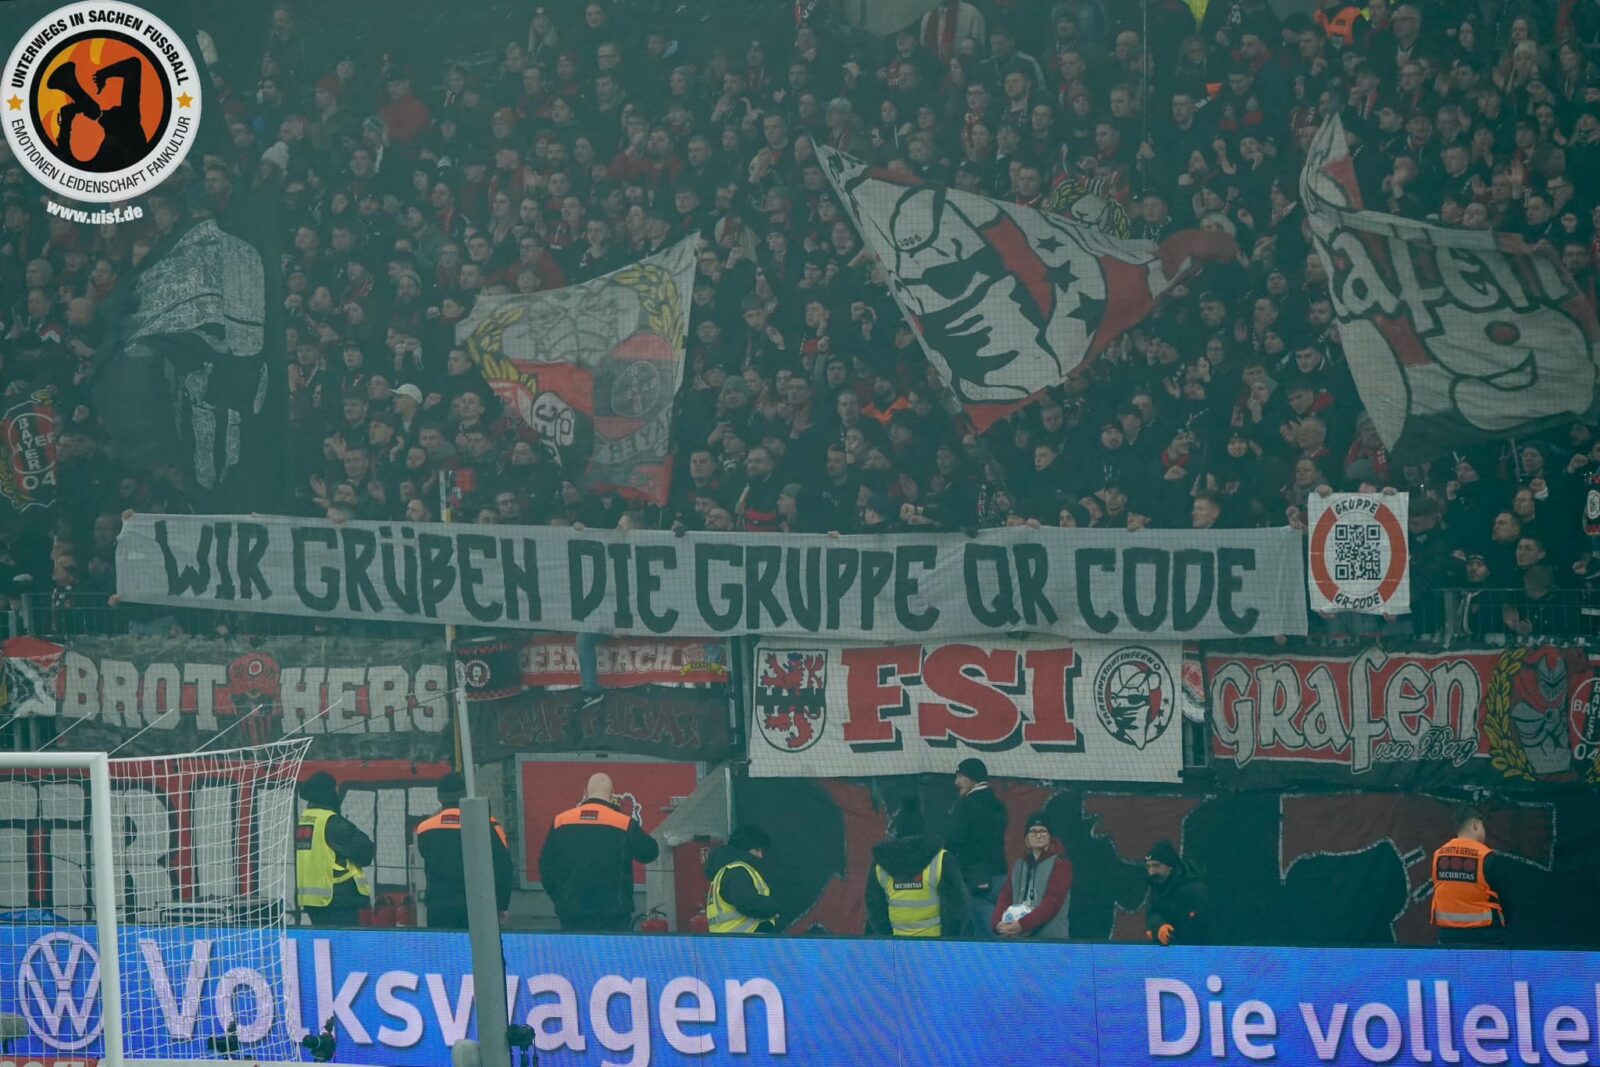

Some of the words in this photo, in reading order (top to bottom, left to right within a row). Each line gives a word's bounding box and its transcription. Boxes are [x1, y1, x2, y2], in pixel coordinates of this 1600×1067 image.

[1335, 498, 1378, 515] GRUPPE
[153, 519, 273, 600] WIR
[567, 538, 680, 634] DIE
[694, 542, 941, 633] GRUPPE
[963, 543, 1059, 630] QR
[1074, 547, 1261, 635] CODE
[841, 644, 1086, 753] FSI
[1438, 871, 1475, 880] SECURITAS
[138, 938, 788, 1067] Volkswagen
[1144, 975, 1278, 1060] Die
[1298, 979, 1600, 1066] vollele
